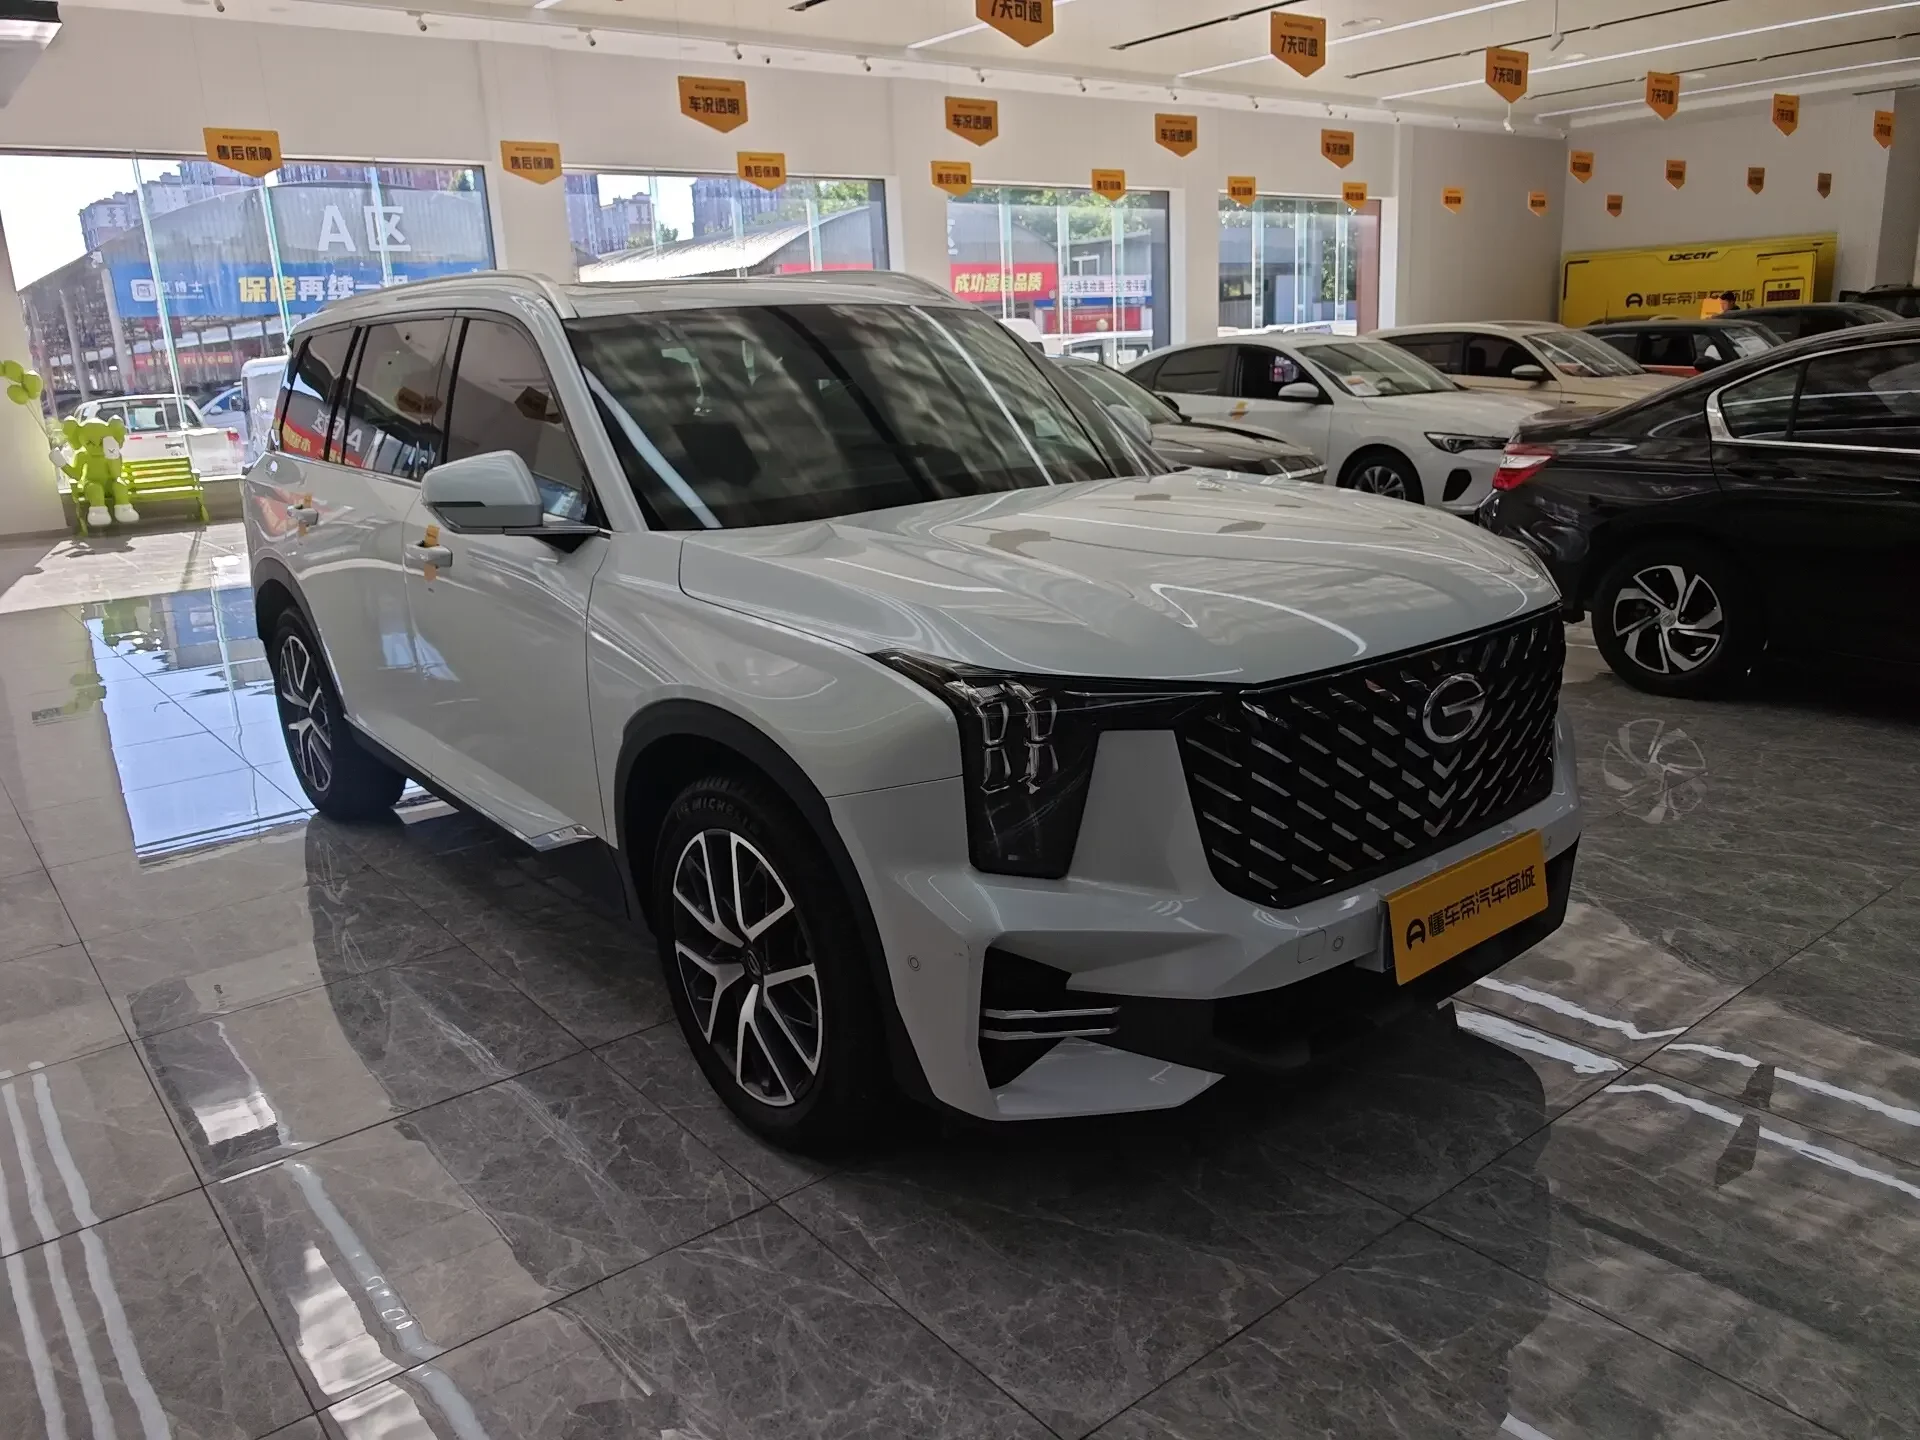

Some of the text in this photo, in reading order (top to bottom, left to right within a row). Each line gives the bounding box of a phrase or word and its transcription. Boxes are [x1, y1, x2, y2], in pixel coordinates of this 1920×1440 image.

[688, 95, 741, 116] 车况透明
[951, 113, 993, 130] 车况透明
[216, 144, 273, 162] 售后保障
[510, 155, 555, 170] 售后保障
[744, 165, 781, 178] 售后保障
[954, 271, 1043, 294] 成功源自品质
[1427, 864, 1537, 938] 懂车帝汽车商城
